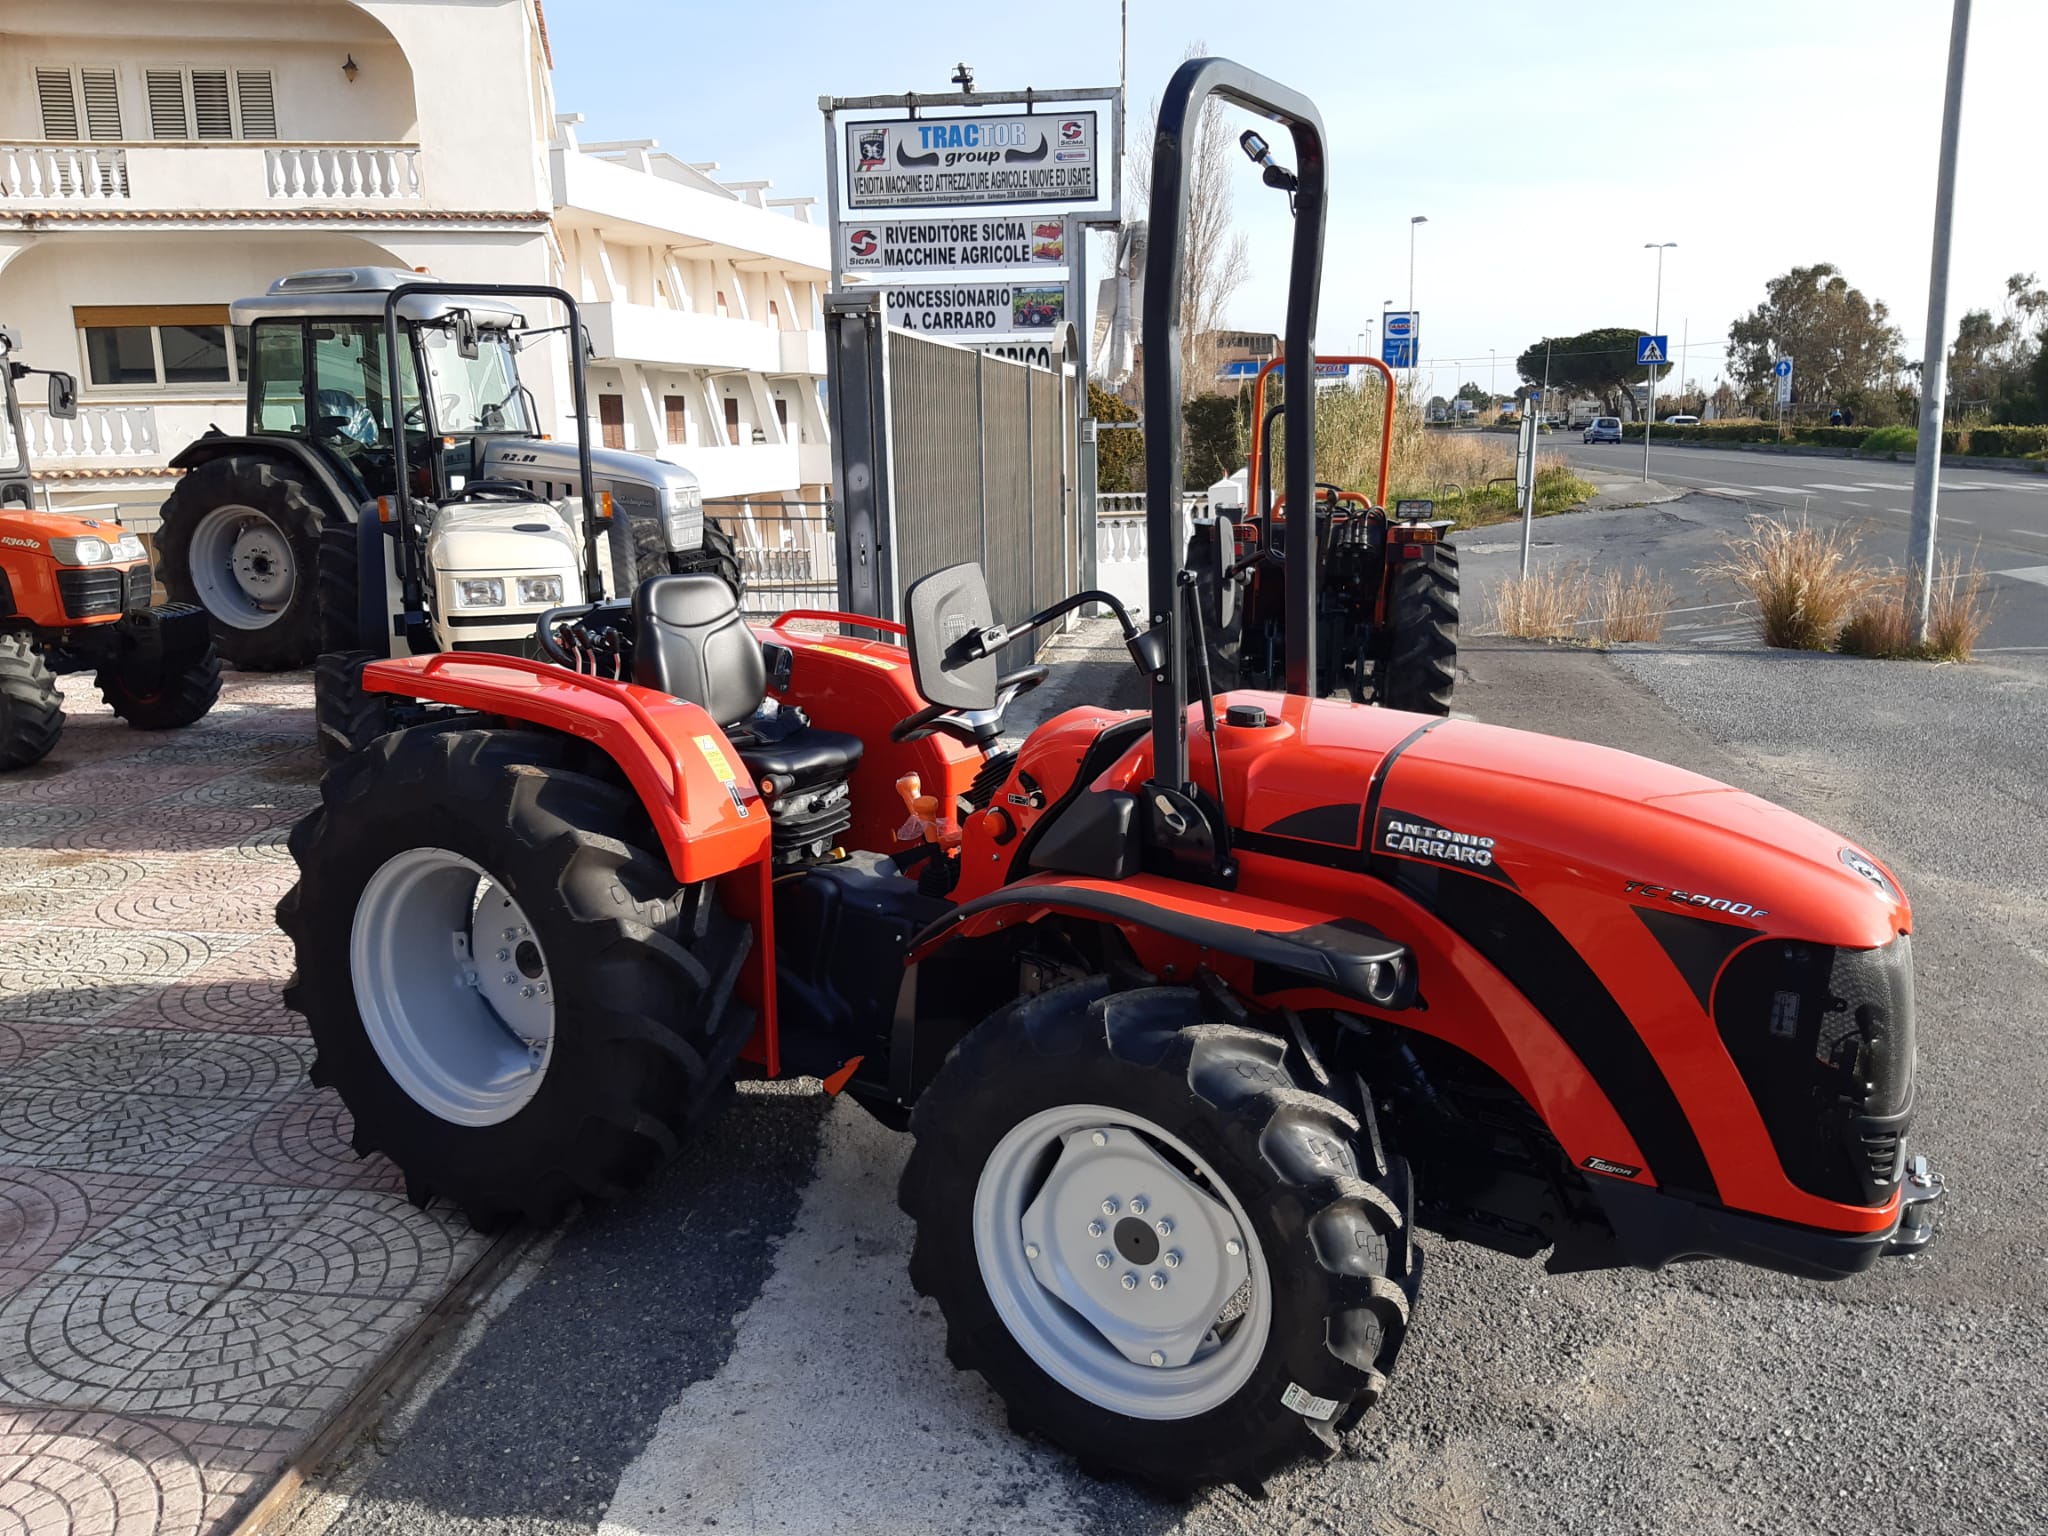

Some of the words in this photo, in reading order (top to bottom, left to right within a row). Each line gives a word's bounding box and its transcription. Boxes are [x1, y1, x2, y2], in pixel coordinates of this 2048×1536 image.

[918, 123, 1026, 149] TRACTOR
[944, 151, 1001, 167] group
[853, 176, 884, 195] VENDITA
[885, 174, 923, 194] MACCHINE
[924, 174, 935, 192] ED
[935, 171, 990, 192] ATTREZZATURE
[991, 169, 1028, 189] AGRICOLE
[1029, 168, 1054, 187] NUOVE
[1055, 168, 1066, 186] ED
[1067, 167, 1091, 185] USATE
[885, 224, 978, 244] RIVENDITORE
[982, 222, 1026, 241] SICMA
[849, 257, 880, 265] SICMA
[884, 247, 956, 266] MACCHINE
[960, 244, 1030, 264] AGRICOLE
[886, 288, 1010, 309] CONCESSIONARIO
[902, 312, 917, 330] A.
[922, 310, 996, 330] CARRARO
[1387, 820, 1496, 848] ANTONIO
[1385, 832, 1493, 867] CARRARO
[1624, 880, 1665, 898] TC
